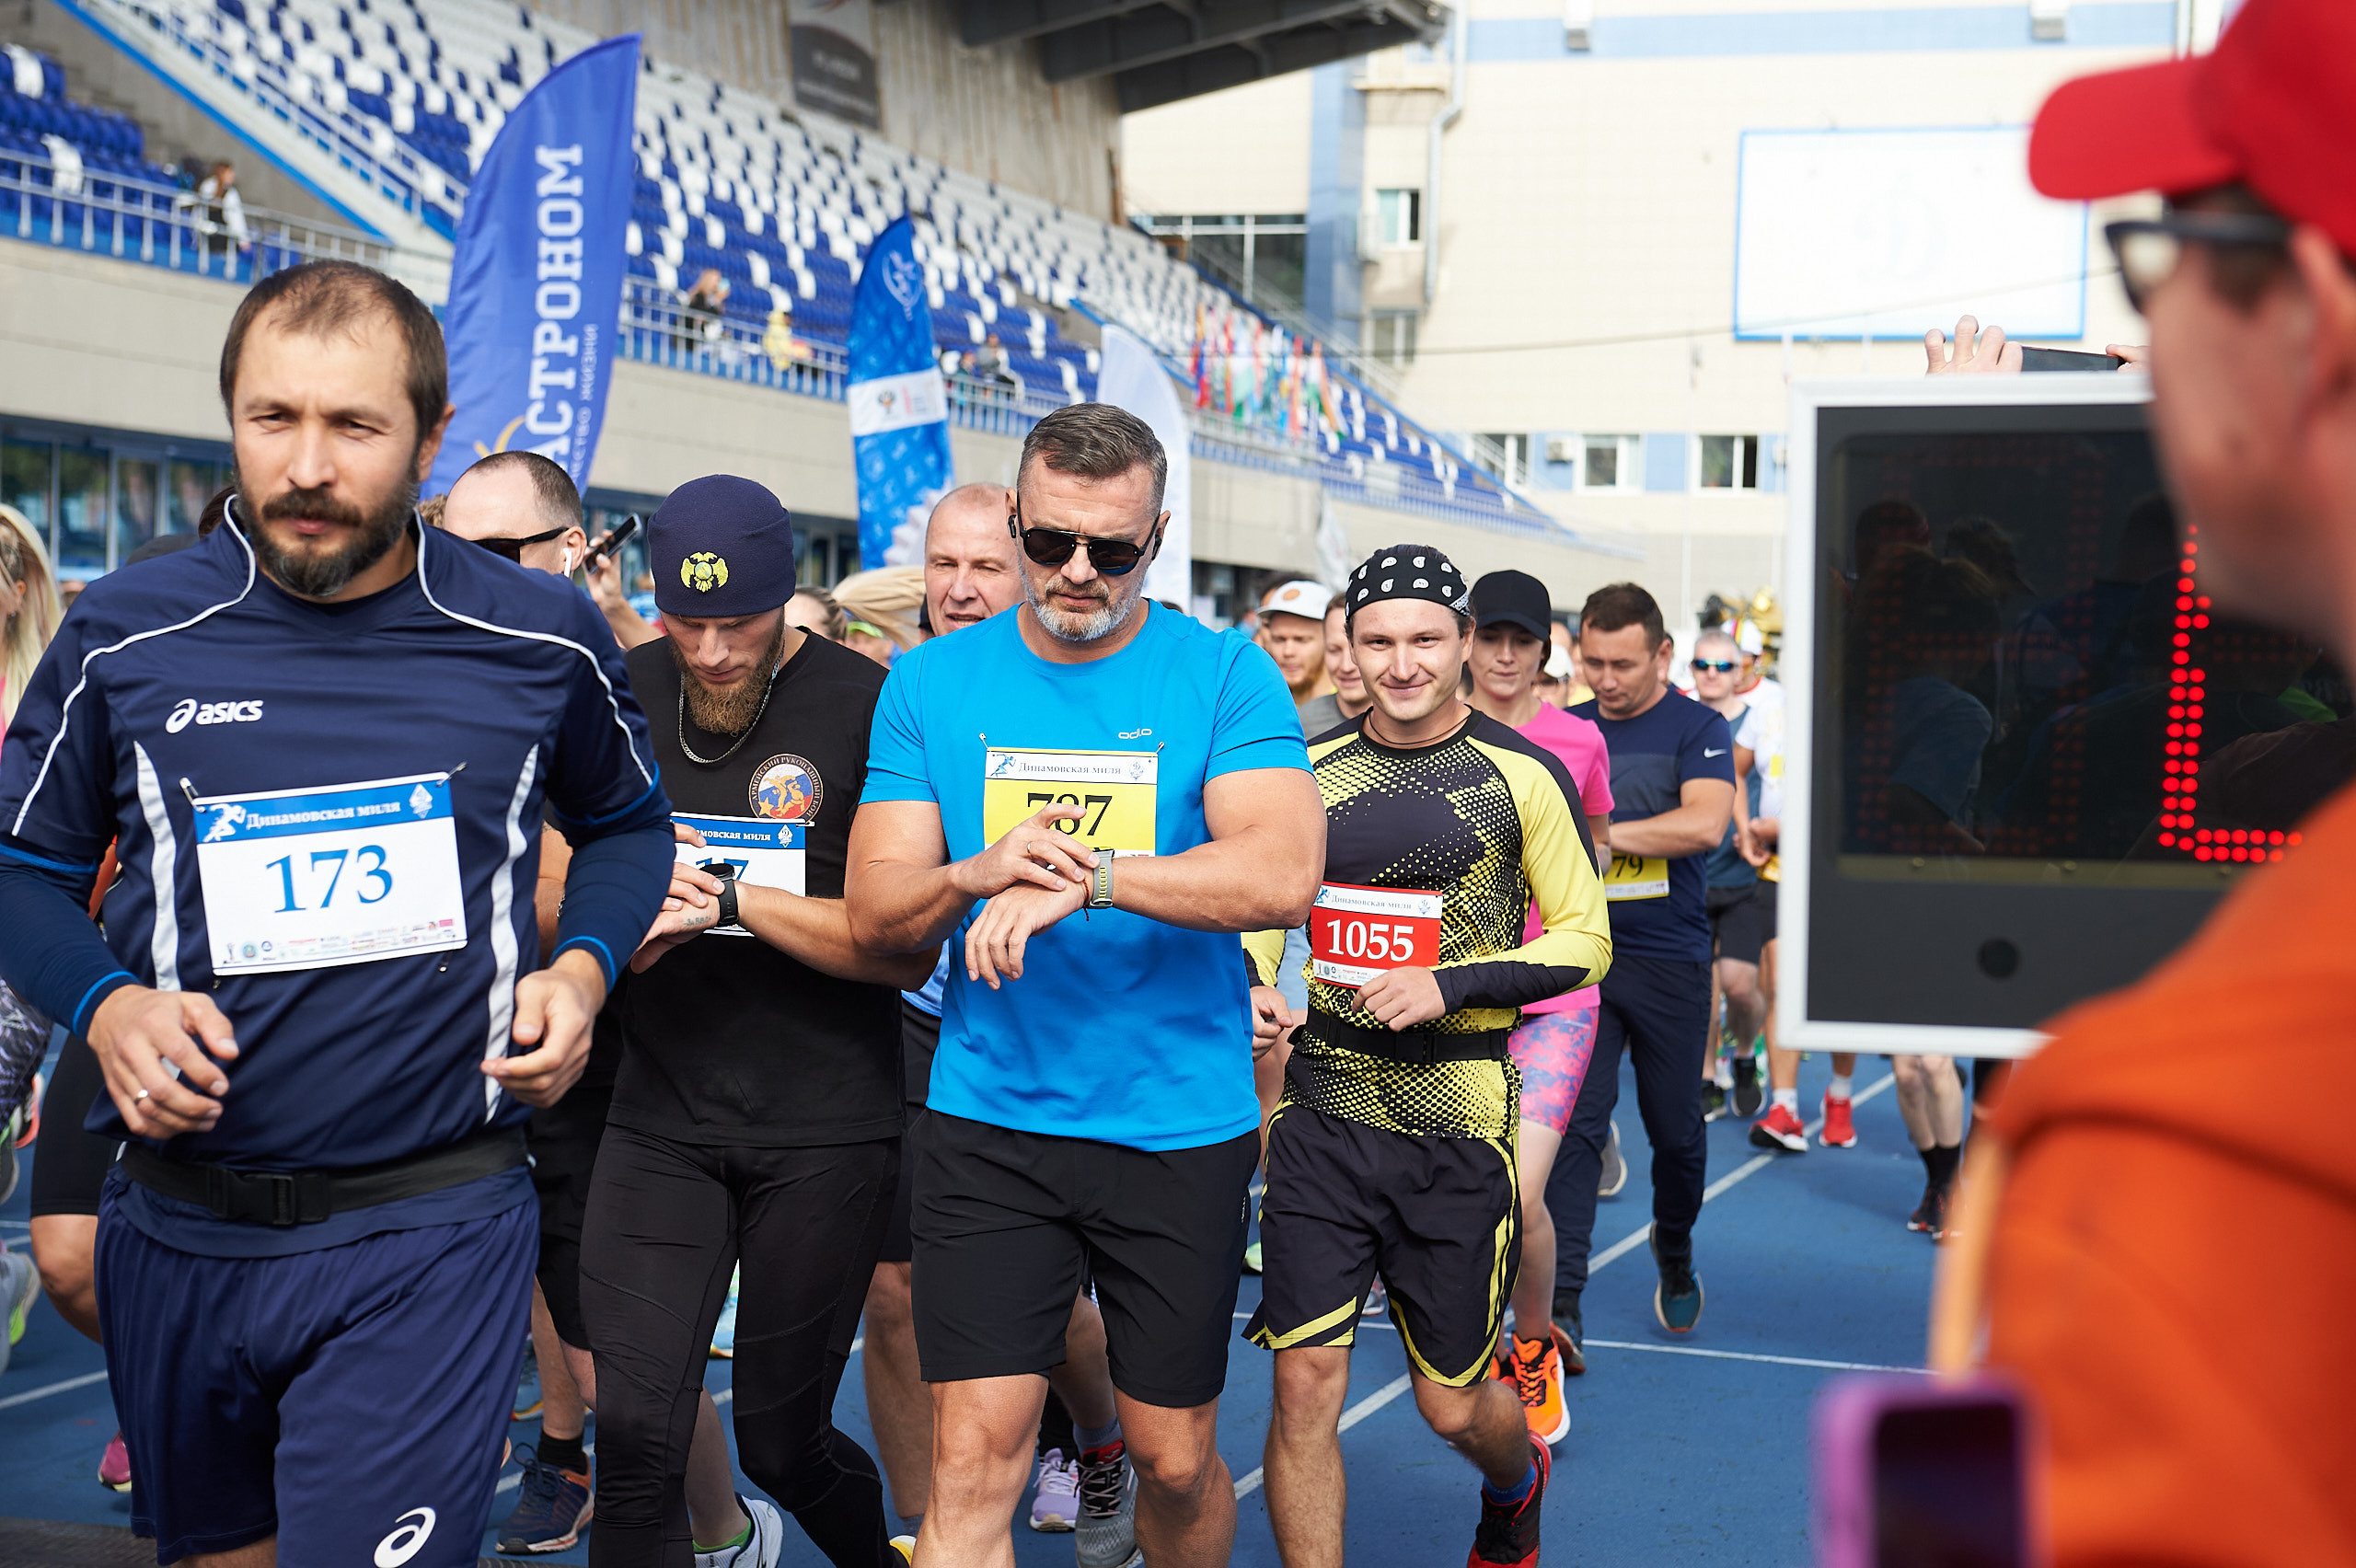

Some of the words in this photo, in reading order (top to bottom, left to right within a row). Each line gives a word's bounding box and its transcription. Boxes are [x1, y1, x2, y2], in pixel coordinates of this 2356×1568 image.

[195, 699, 264, 725] asics
[1018, 762, 1090, 775] Динамовская
[1091, 767, 1122, 775] миля
[246, 806, 354, 830] Динамовская
[356, 801, 402, 817] миля
[743, 832, 771, 841] миля
[265, 844, 393, 914] 173
[1331, 894, 1385, 907] Динамовская
[1388, 902, 1412, 910] миля
[1326, 918, 1415, 963] 1055
